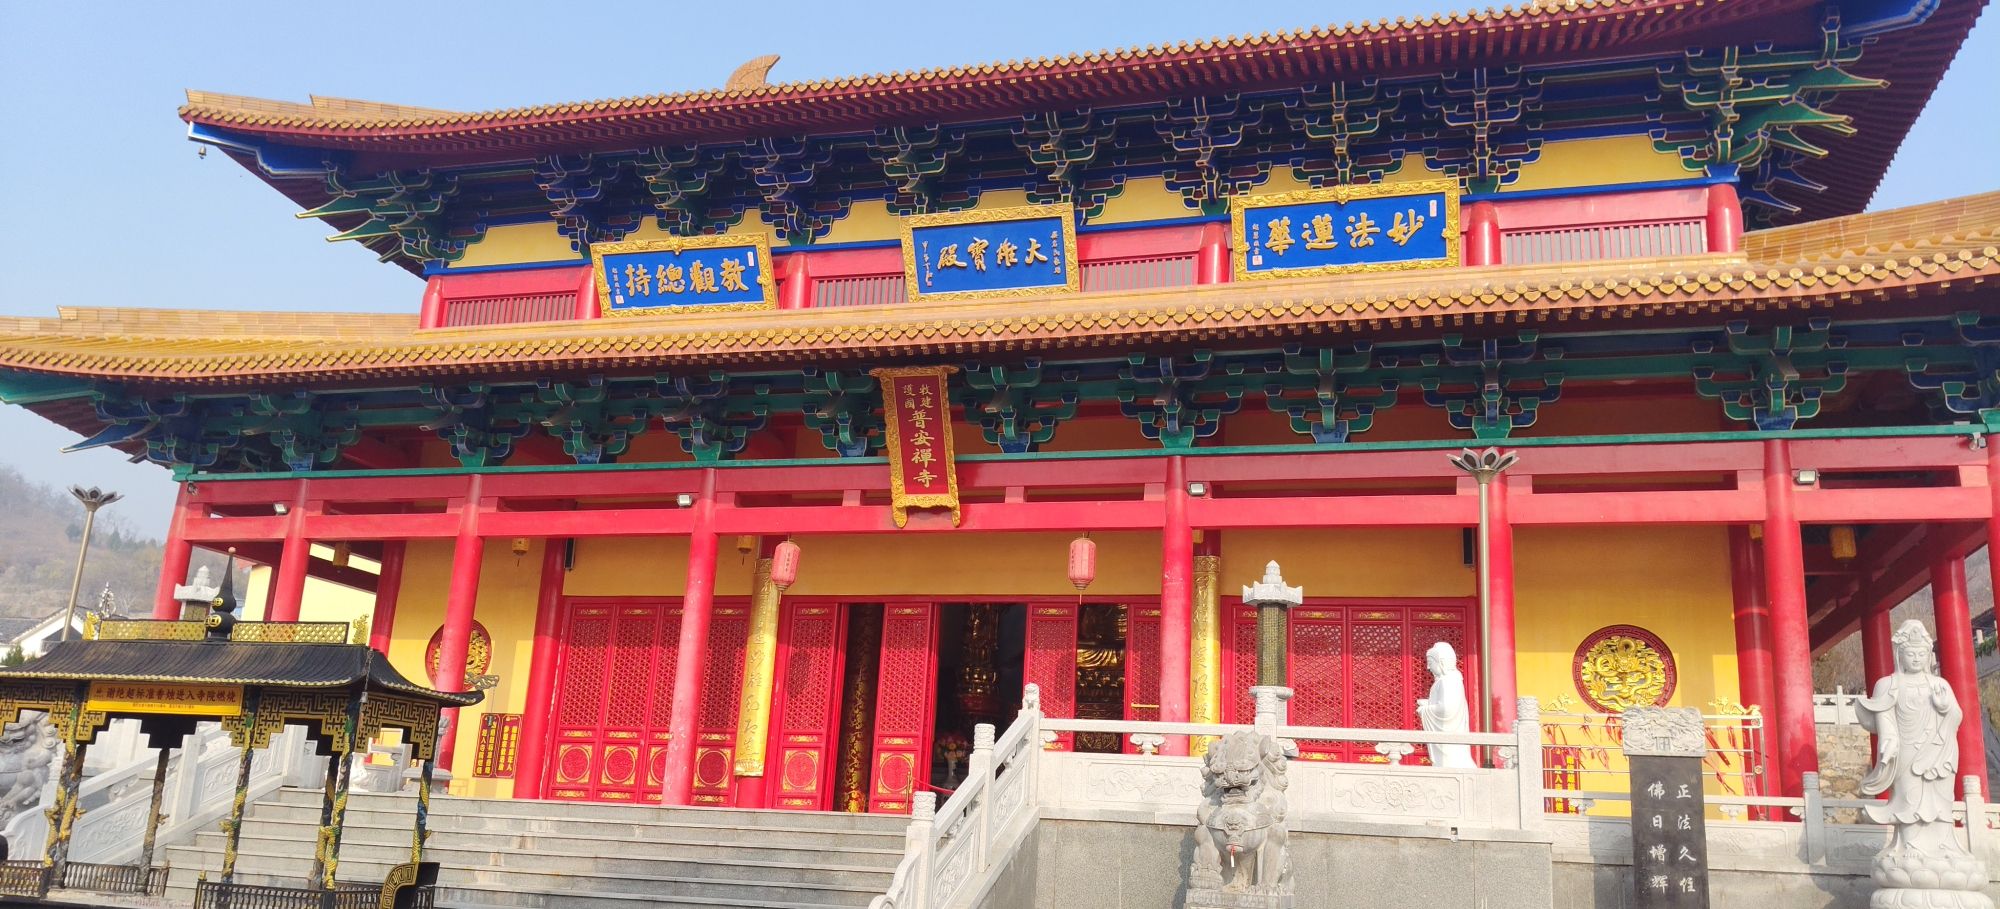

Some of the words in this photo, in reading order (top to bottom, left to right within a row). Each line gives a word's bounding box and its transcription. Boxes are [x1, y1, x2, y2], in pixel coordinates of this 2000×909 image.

[1265, 208, 1426, 256] 妙法蓮華
[625, 257, 750, 297] 教觀總持
[908, 410, 938, 488] 普安禪寺
[1675, 784, 1697, 893] 正法久住
